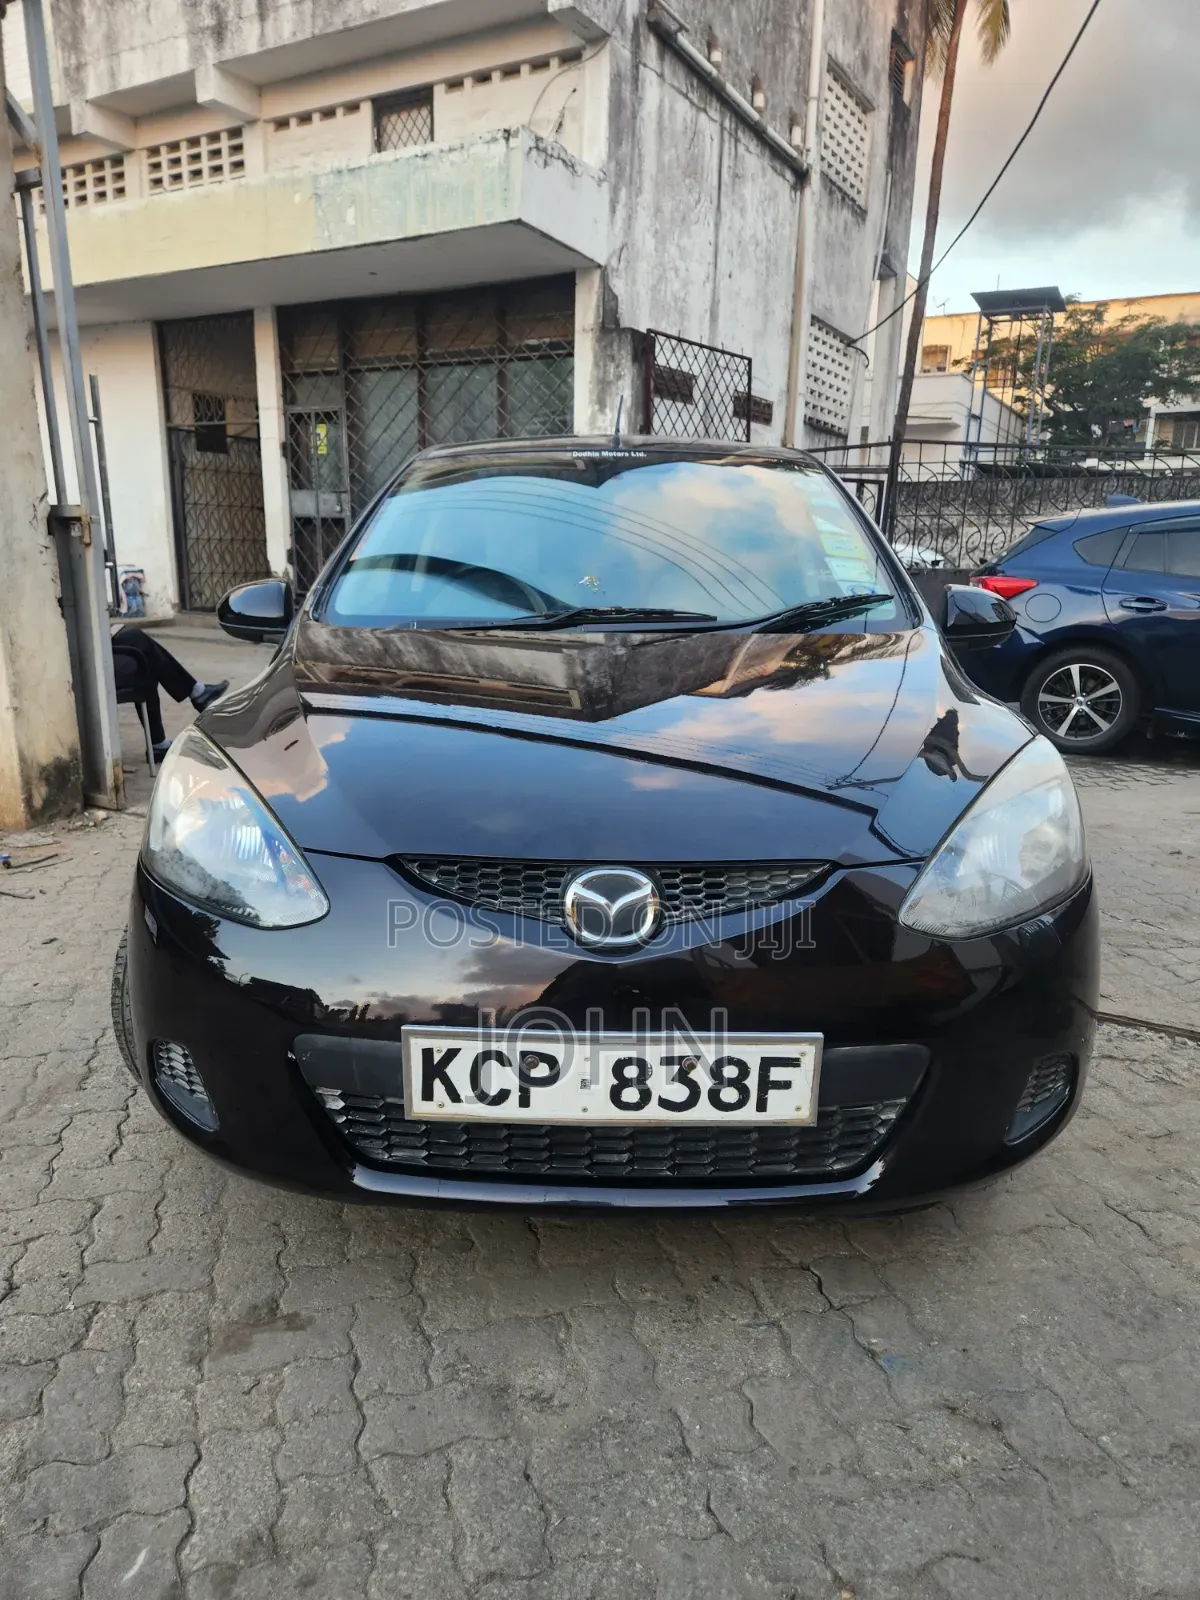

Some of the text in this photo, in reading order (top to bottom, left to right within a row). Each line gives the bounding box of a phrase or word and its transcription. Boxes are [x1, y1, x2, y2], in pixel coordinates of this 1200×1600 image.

[572, 450, 647, 458] Dodhia Motors Ltd.
[420, 1047, 803, 1113] KCP 838F
